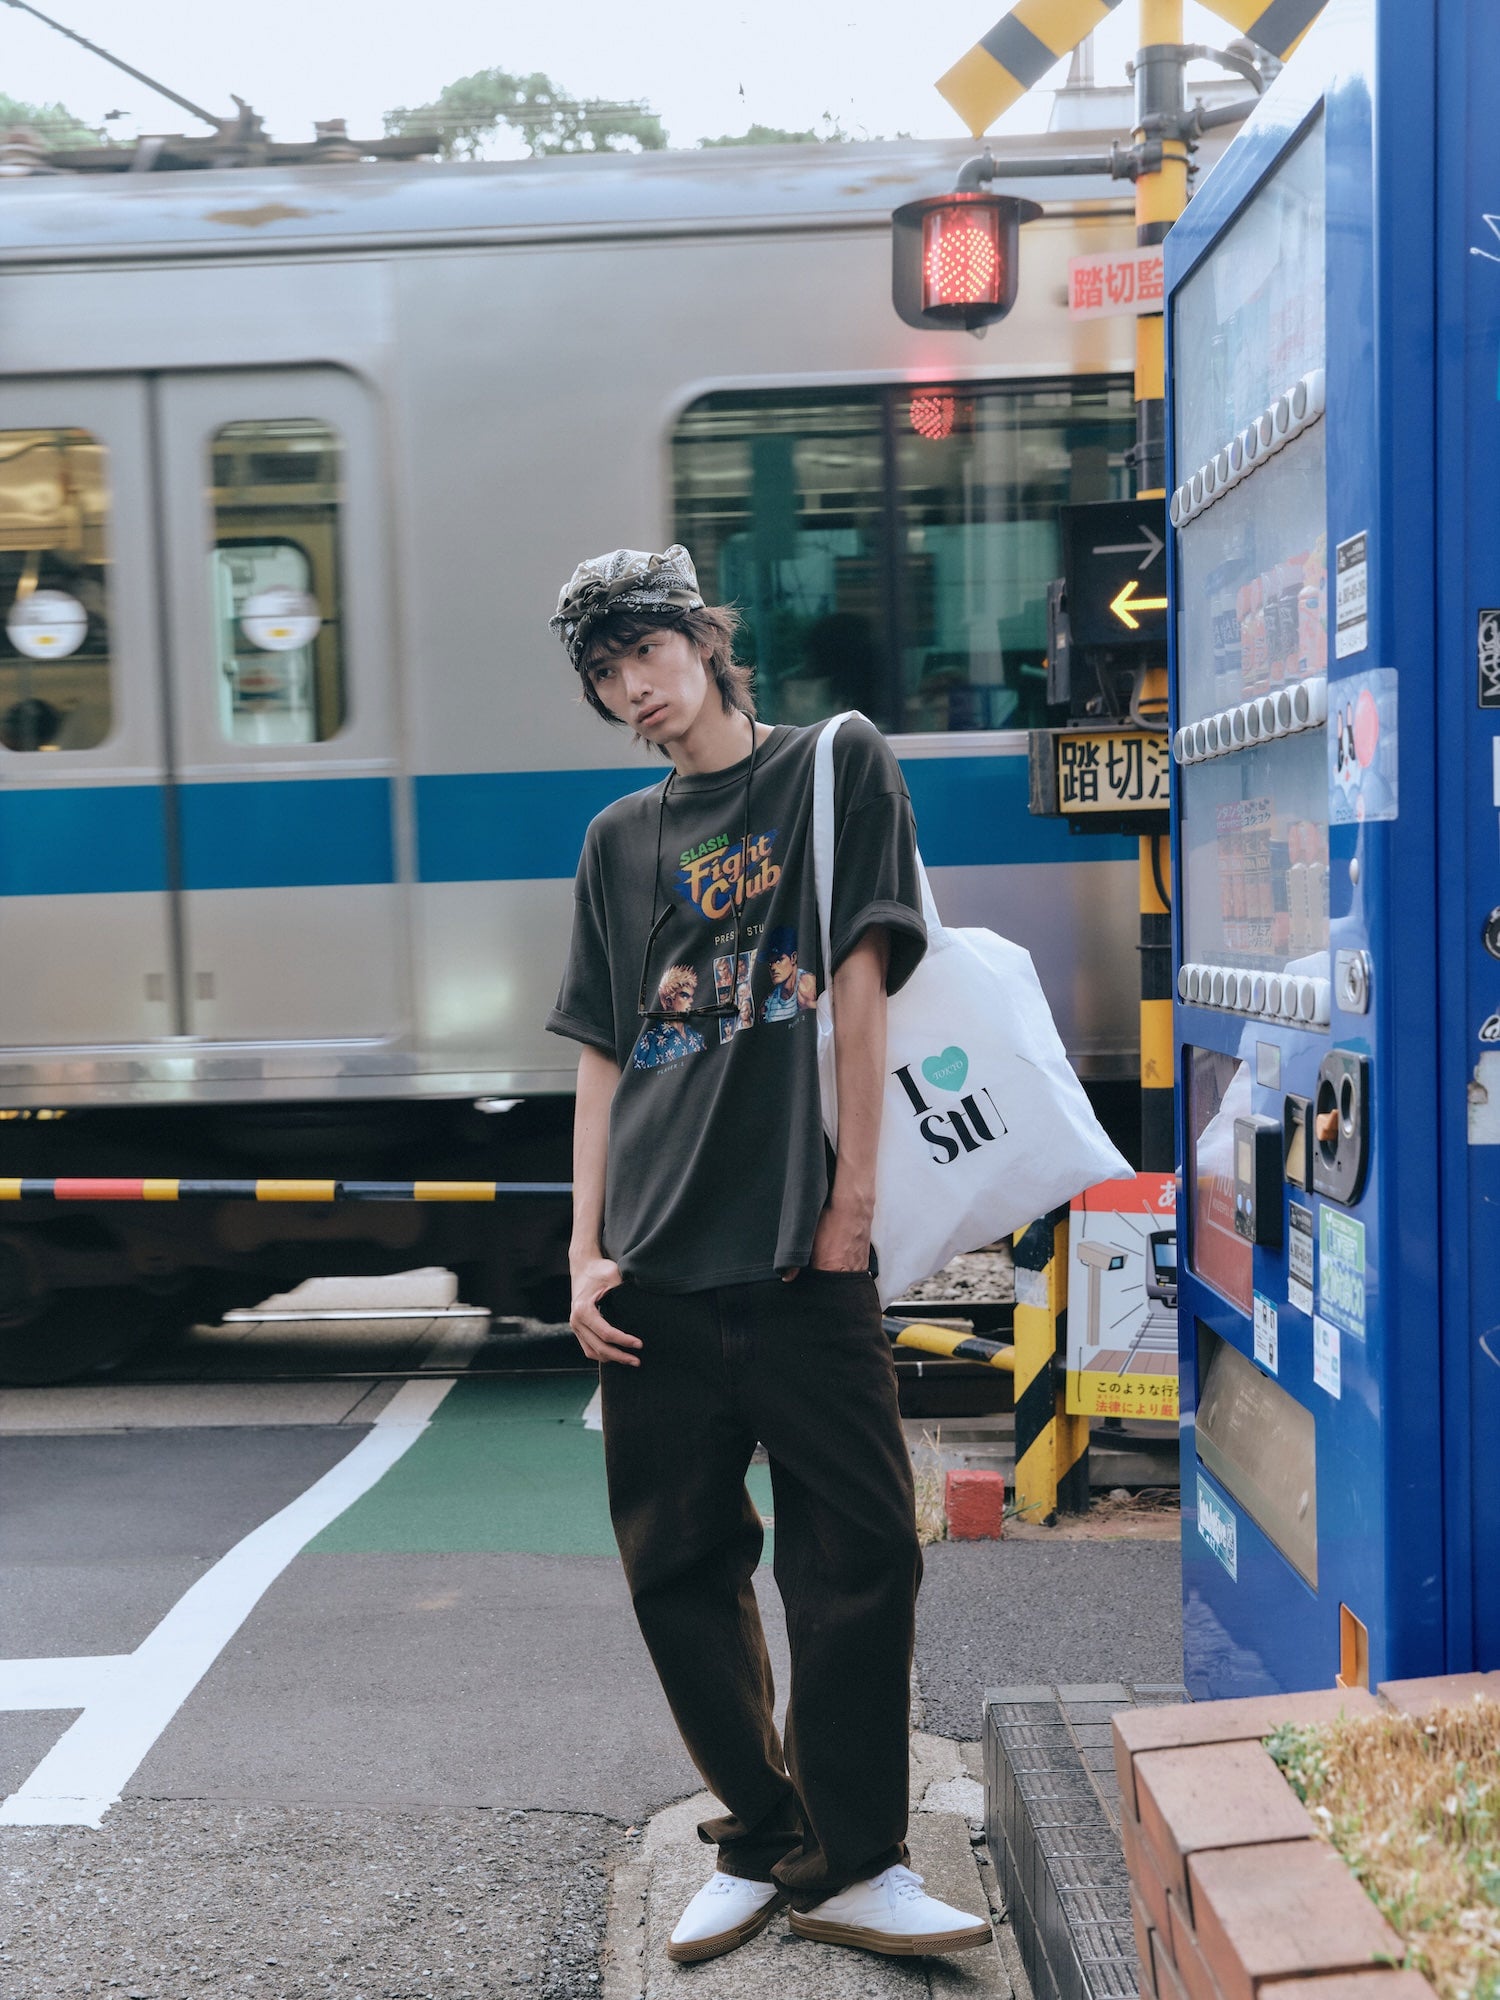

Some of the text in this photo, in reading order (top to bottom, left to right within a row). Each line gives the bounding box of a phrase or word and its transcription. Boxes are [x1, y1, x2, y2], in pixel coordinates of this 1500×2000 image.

[1073, 257, 1164, 309] 踏切監
[679, 833, 730, 866] SLASH
[680, 833, 772, 904] Fight
[701, 857, 783, 920] Club
[891, 1063, 933, 1117] I
[932, 1059, 964, 1081] TOKYO
[1096, 1399, 1179, 1418] 法律により厳
[1097, 1381, 1179, 1398] このような行
